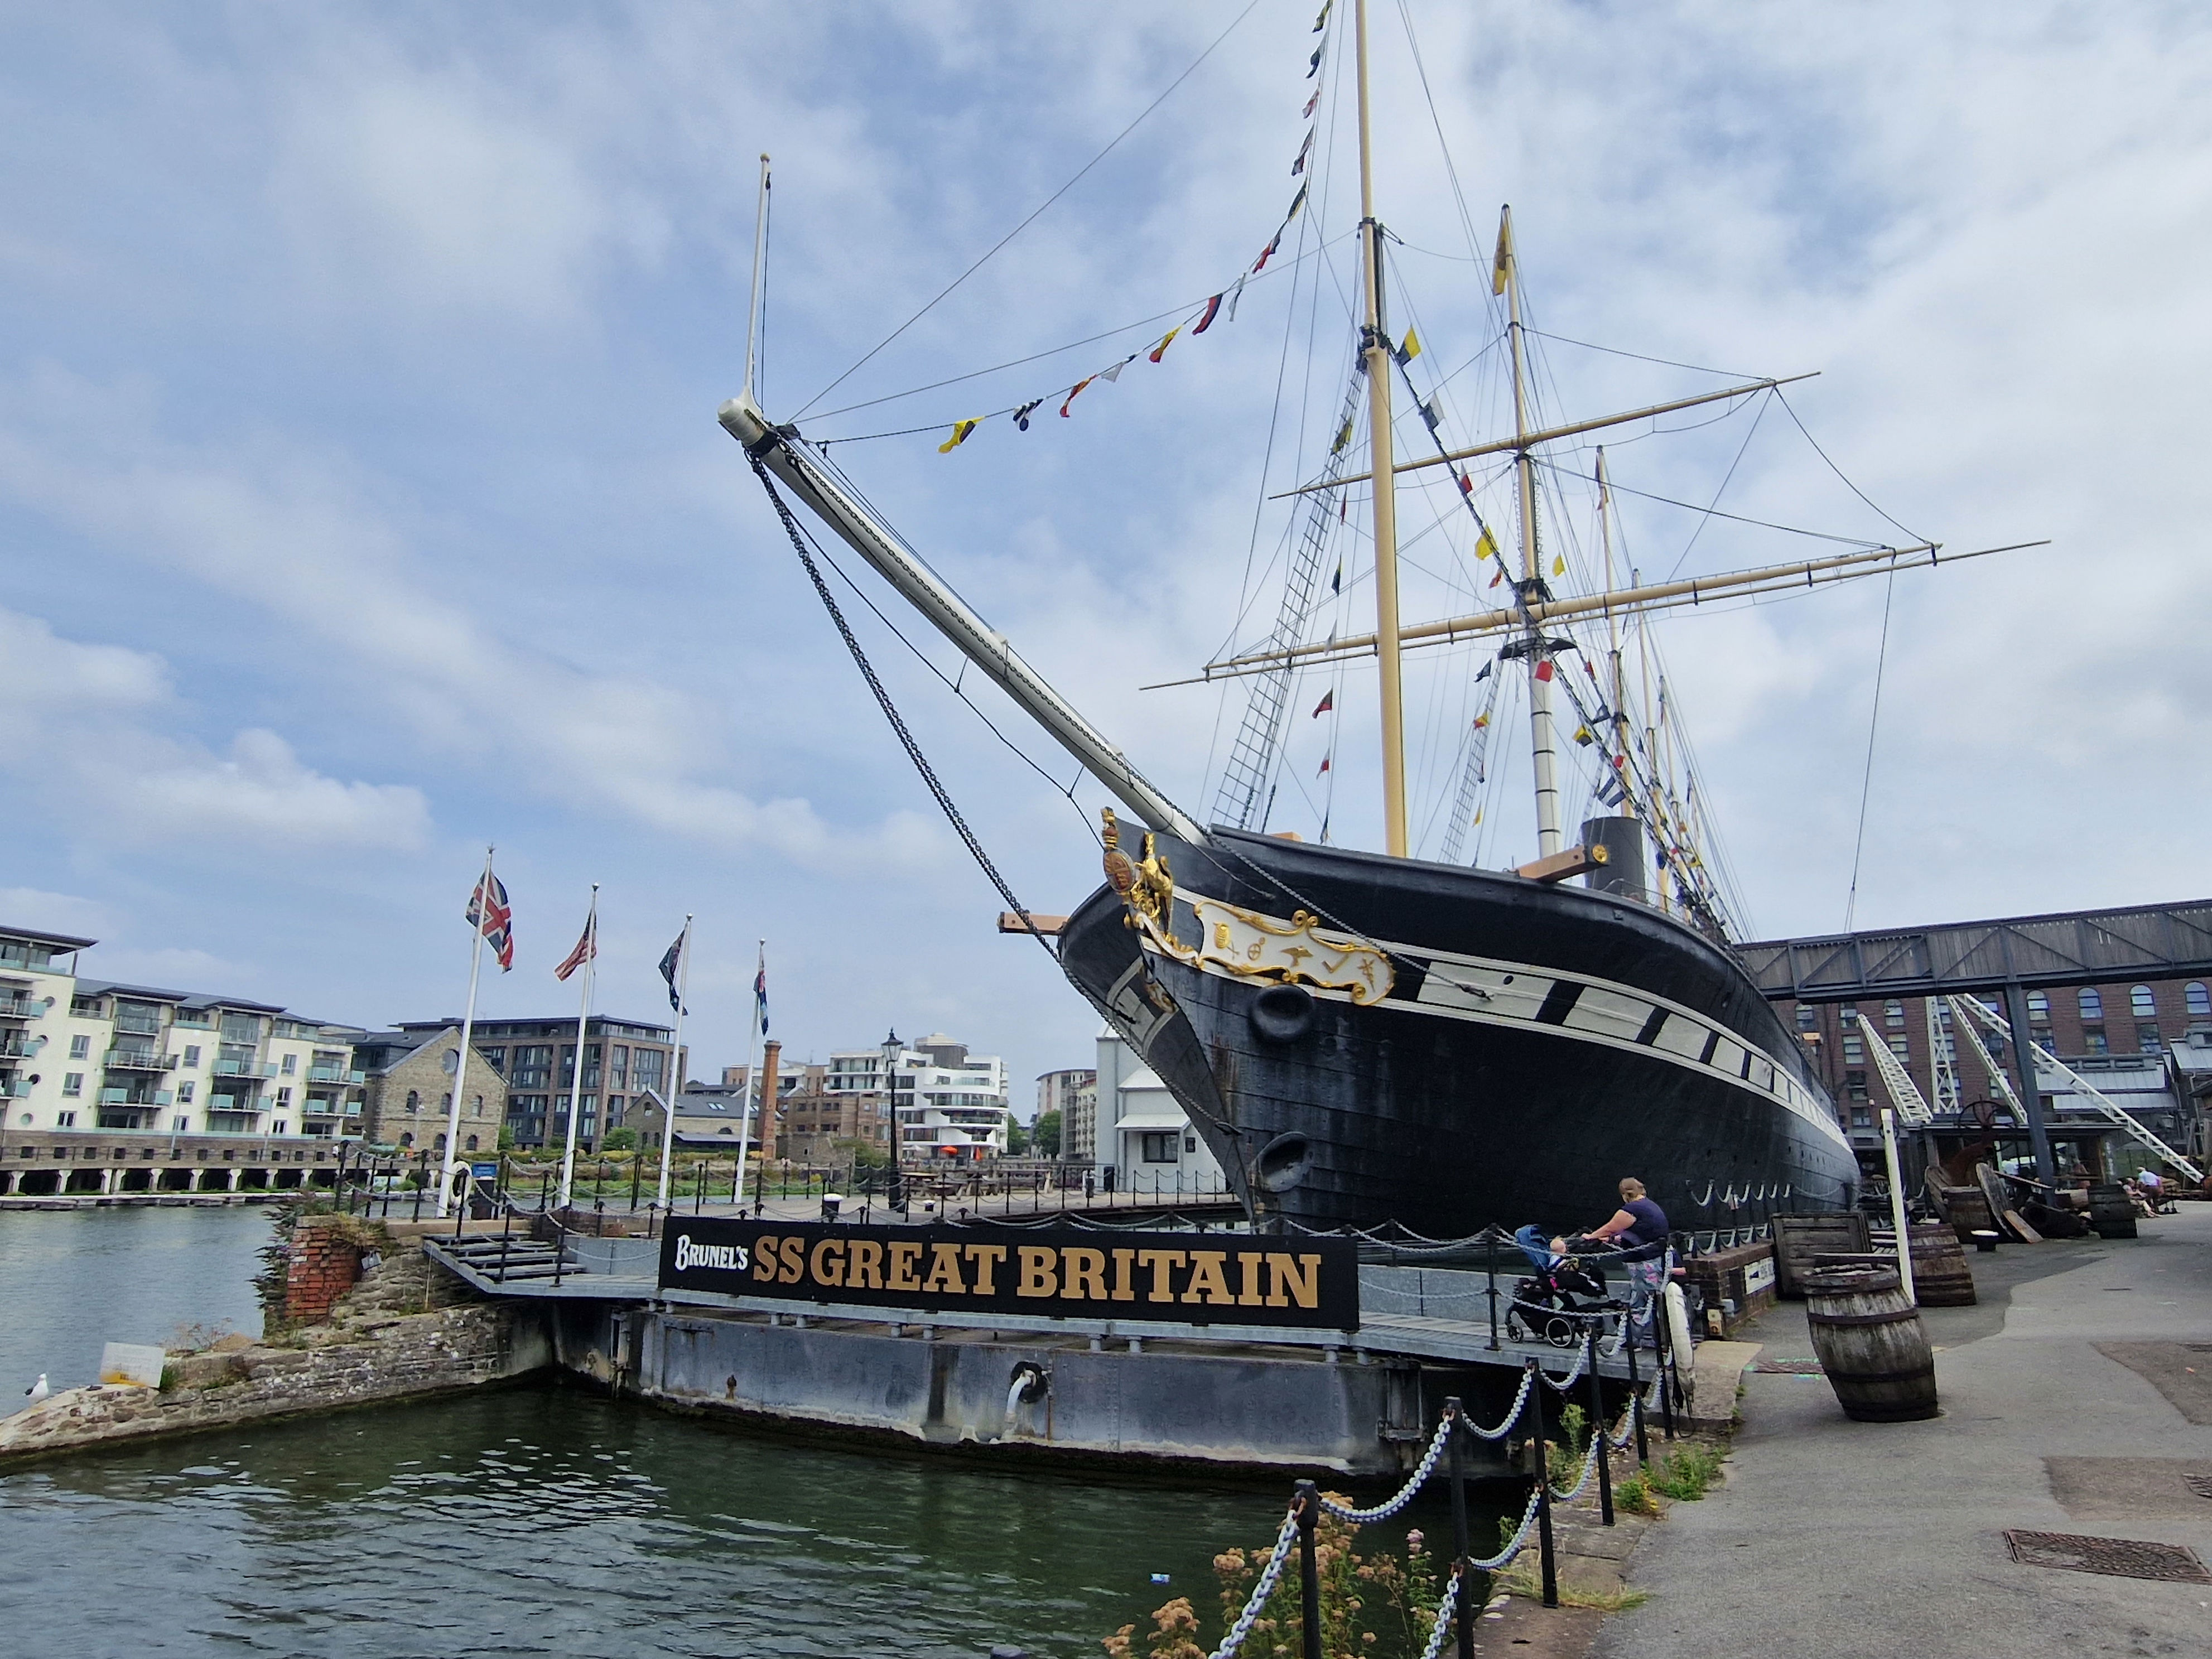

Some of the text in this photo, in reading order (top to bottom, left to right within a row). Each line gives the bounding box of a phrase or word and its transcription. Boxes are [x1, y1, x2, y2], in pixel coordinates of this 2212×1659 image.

[675, 1234, 1322, 1308] BRUNEL'S SS GREAT BRITAIN
